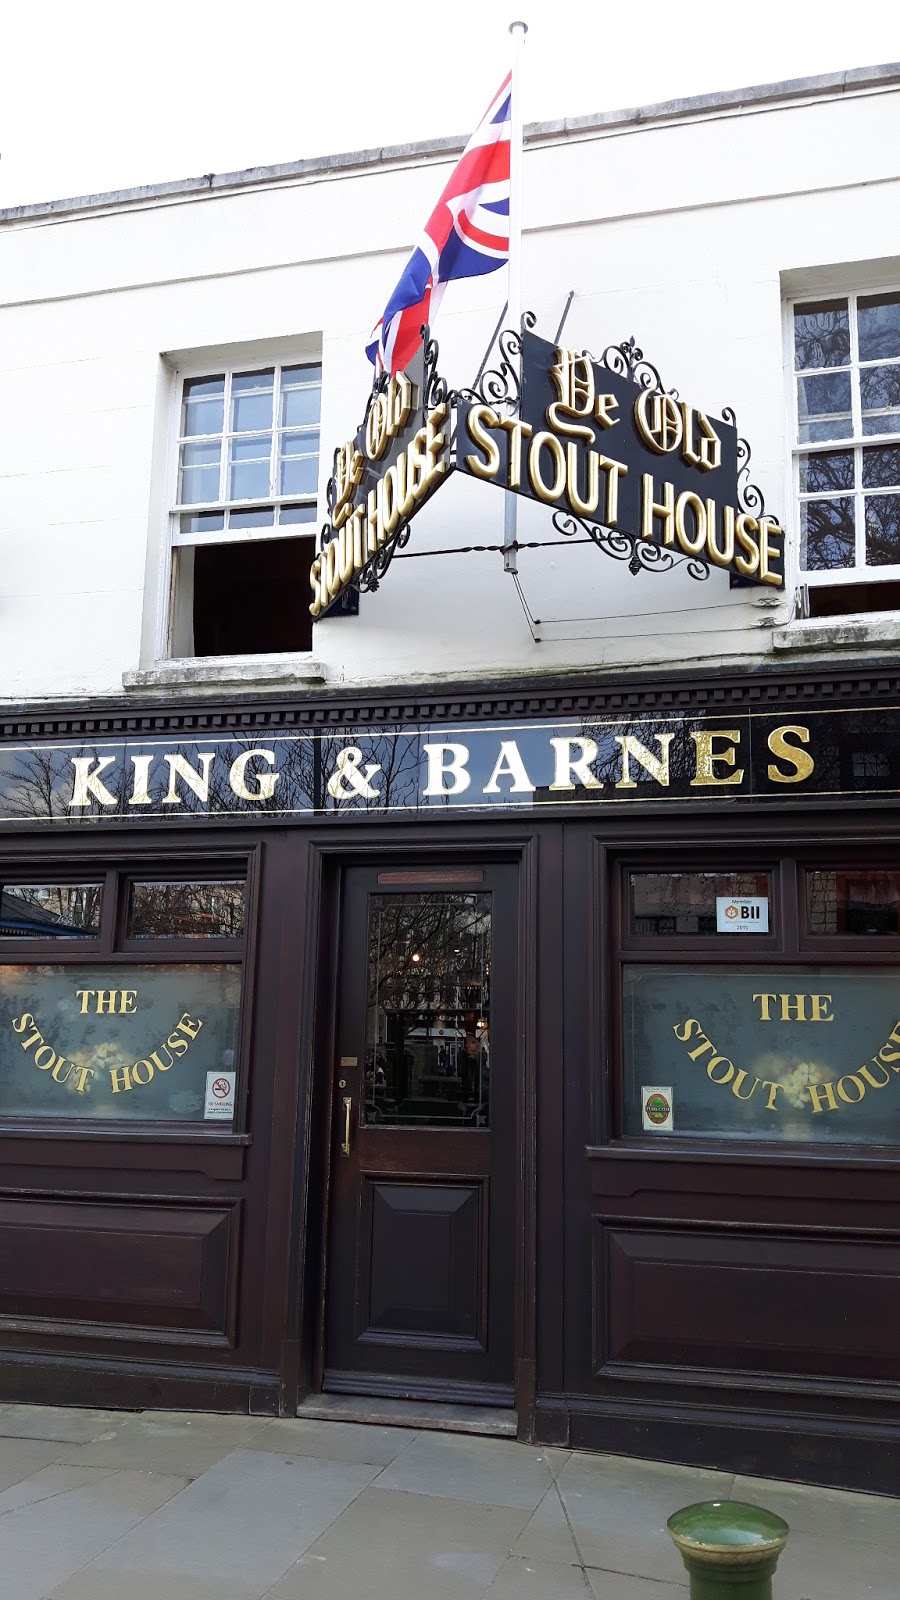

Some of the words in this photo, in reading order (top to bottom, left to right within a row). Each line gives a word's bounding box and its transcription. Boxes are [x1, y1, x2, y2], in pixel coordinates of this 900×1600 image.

[547, 347, 620, 444] Ye
[634, 388, 722, 471] Old
[309, 502, 366, 616] STOUT
[367, 402, 447, 552] HOUSE
[465, 404, 628, 528] STOUT
[641, 472, 784, 586] HOUSE
[68, 748, 280, 807] KING
[327, 746, 381, 800] &
[422, 725, 816, 797] BARNES
[741, 906, 760, 919] BII
[76, 990, 138, 1014] THE
[752, 993, 834, 1022] THE
[12, 1012, 95, 1093] STOUT
[108, 1012, 203, 1094] HOUSE
[672, 1018, 785, 1111] STOUT
